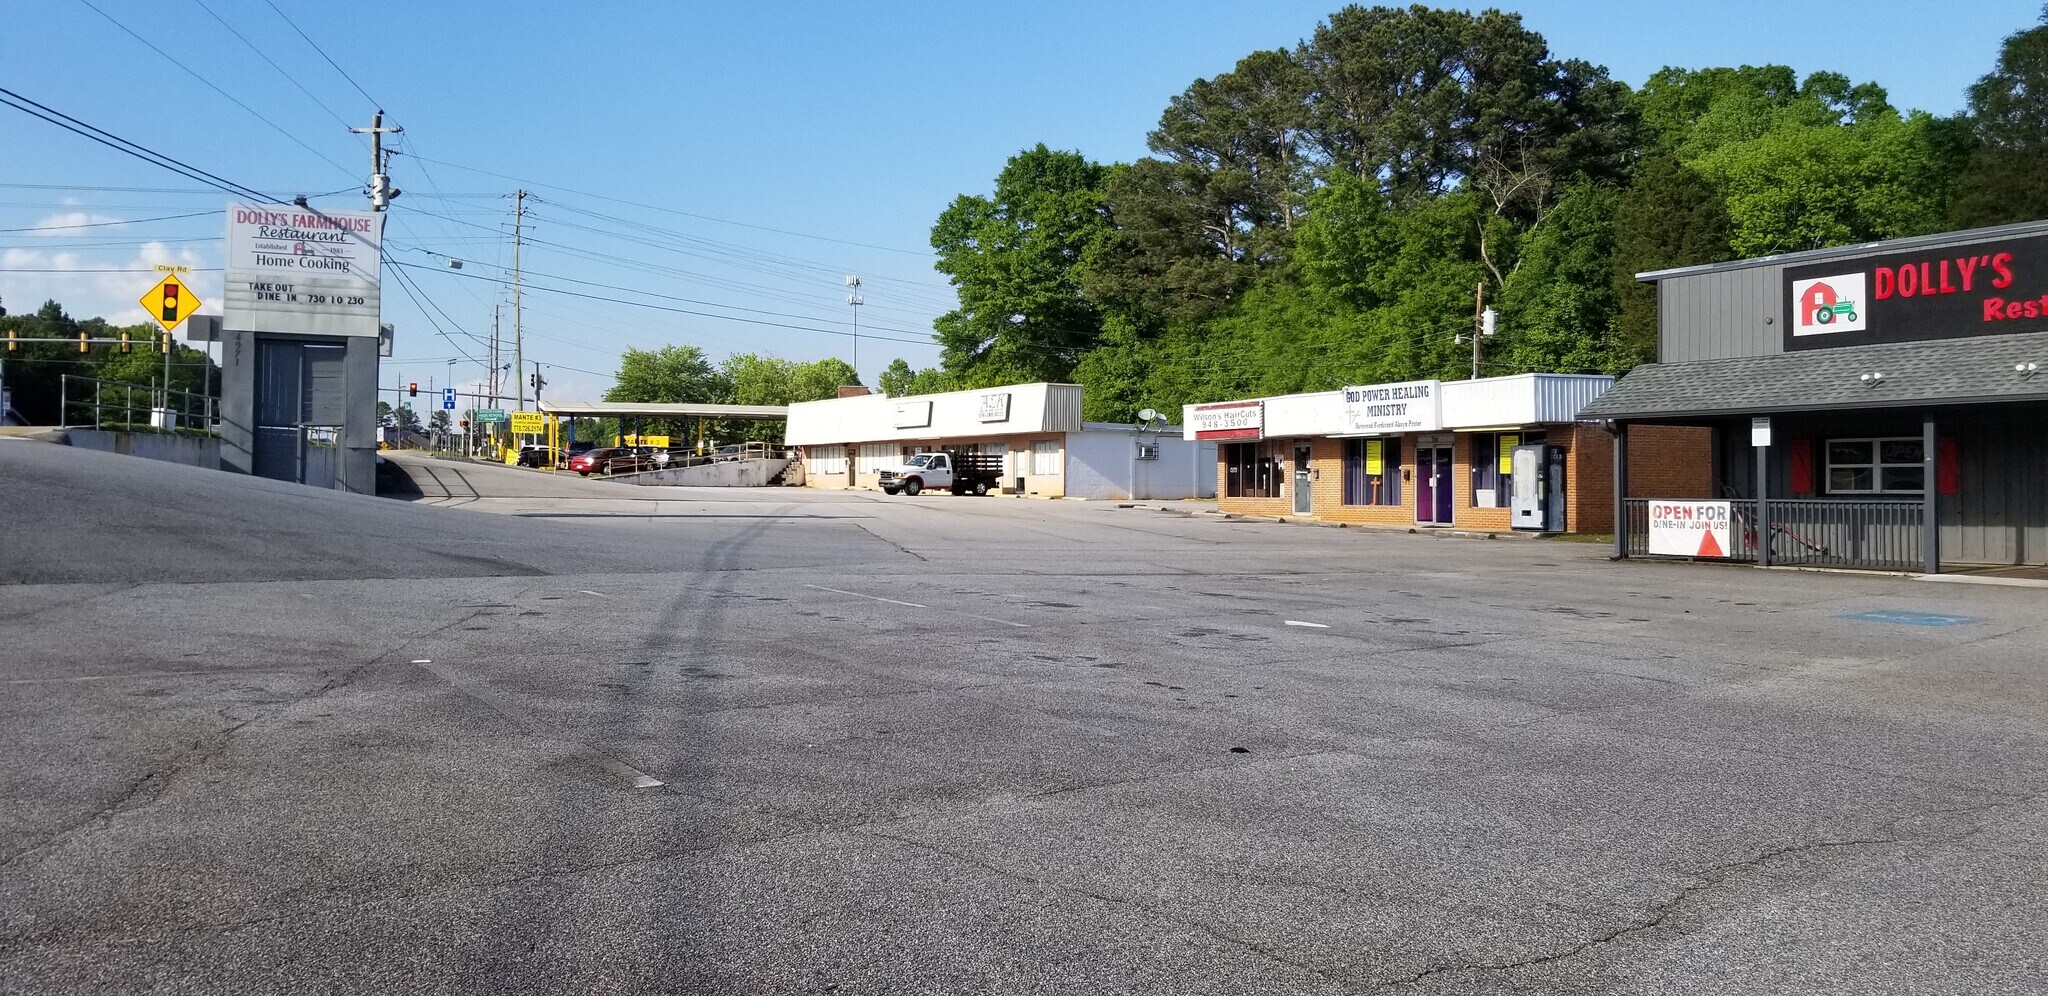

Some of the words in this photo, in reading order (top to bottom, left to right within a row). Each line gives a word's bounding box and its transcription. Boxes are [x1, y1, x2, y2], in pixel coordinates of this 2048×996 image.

[237, 210, 288, 226] DOLLY'S
[292, 214, 371, 232] FARMHOUSE
[259, 225, 350, 242] Restaurant
[255, 242, 288, 251] Established
[256, 254, 294, 267] Home
[299, 257, 350, 273] Cooking
[1875, 252, 2013, 301] DOLLY'S
[249, 282, 272, 292] TAKE
[275, 283, 294, 293] OUT
[257, 292, 281, 301] DINE
[286, 293, 297, 302] IN
[308, 294, 326, 304] 730
[347, 297, 364, 306] 230
[1346, 391, 1360, 403] GOD
[1362, 388, 1390, 402] POWER
[1392, 385, 1429, 400] HEALING
[1193, 413, 1222, 421] Wilson's
[1223, 410, 1257, 419] HairCuts
[1366, 403, 1407, 417] MINISTRY
[1202, 418, 1248, 428] 948-3500
[1652, 504, 1693, 520] OPEN
[1696, 505, 1727, 521] FOR
[1653, 520, 1686, 529] DINE-IN
[1689, 520, 1711, 530] JOIN
[1713, 521, 1728, 530] US!
